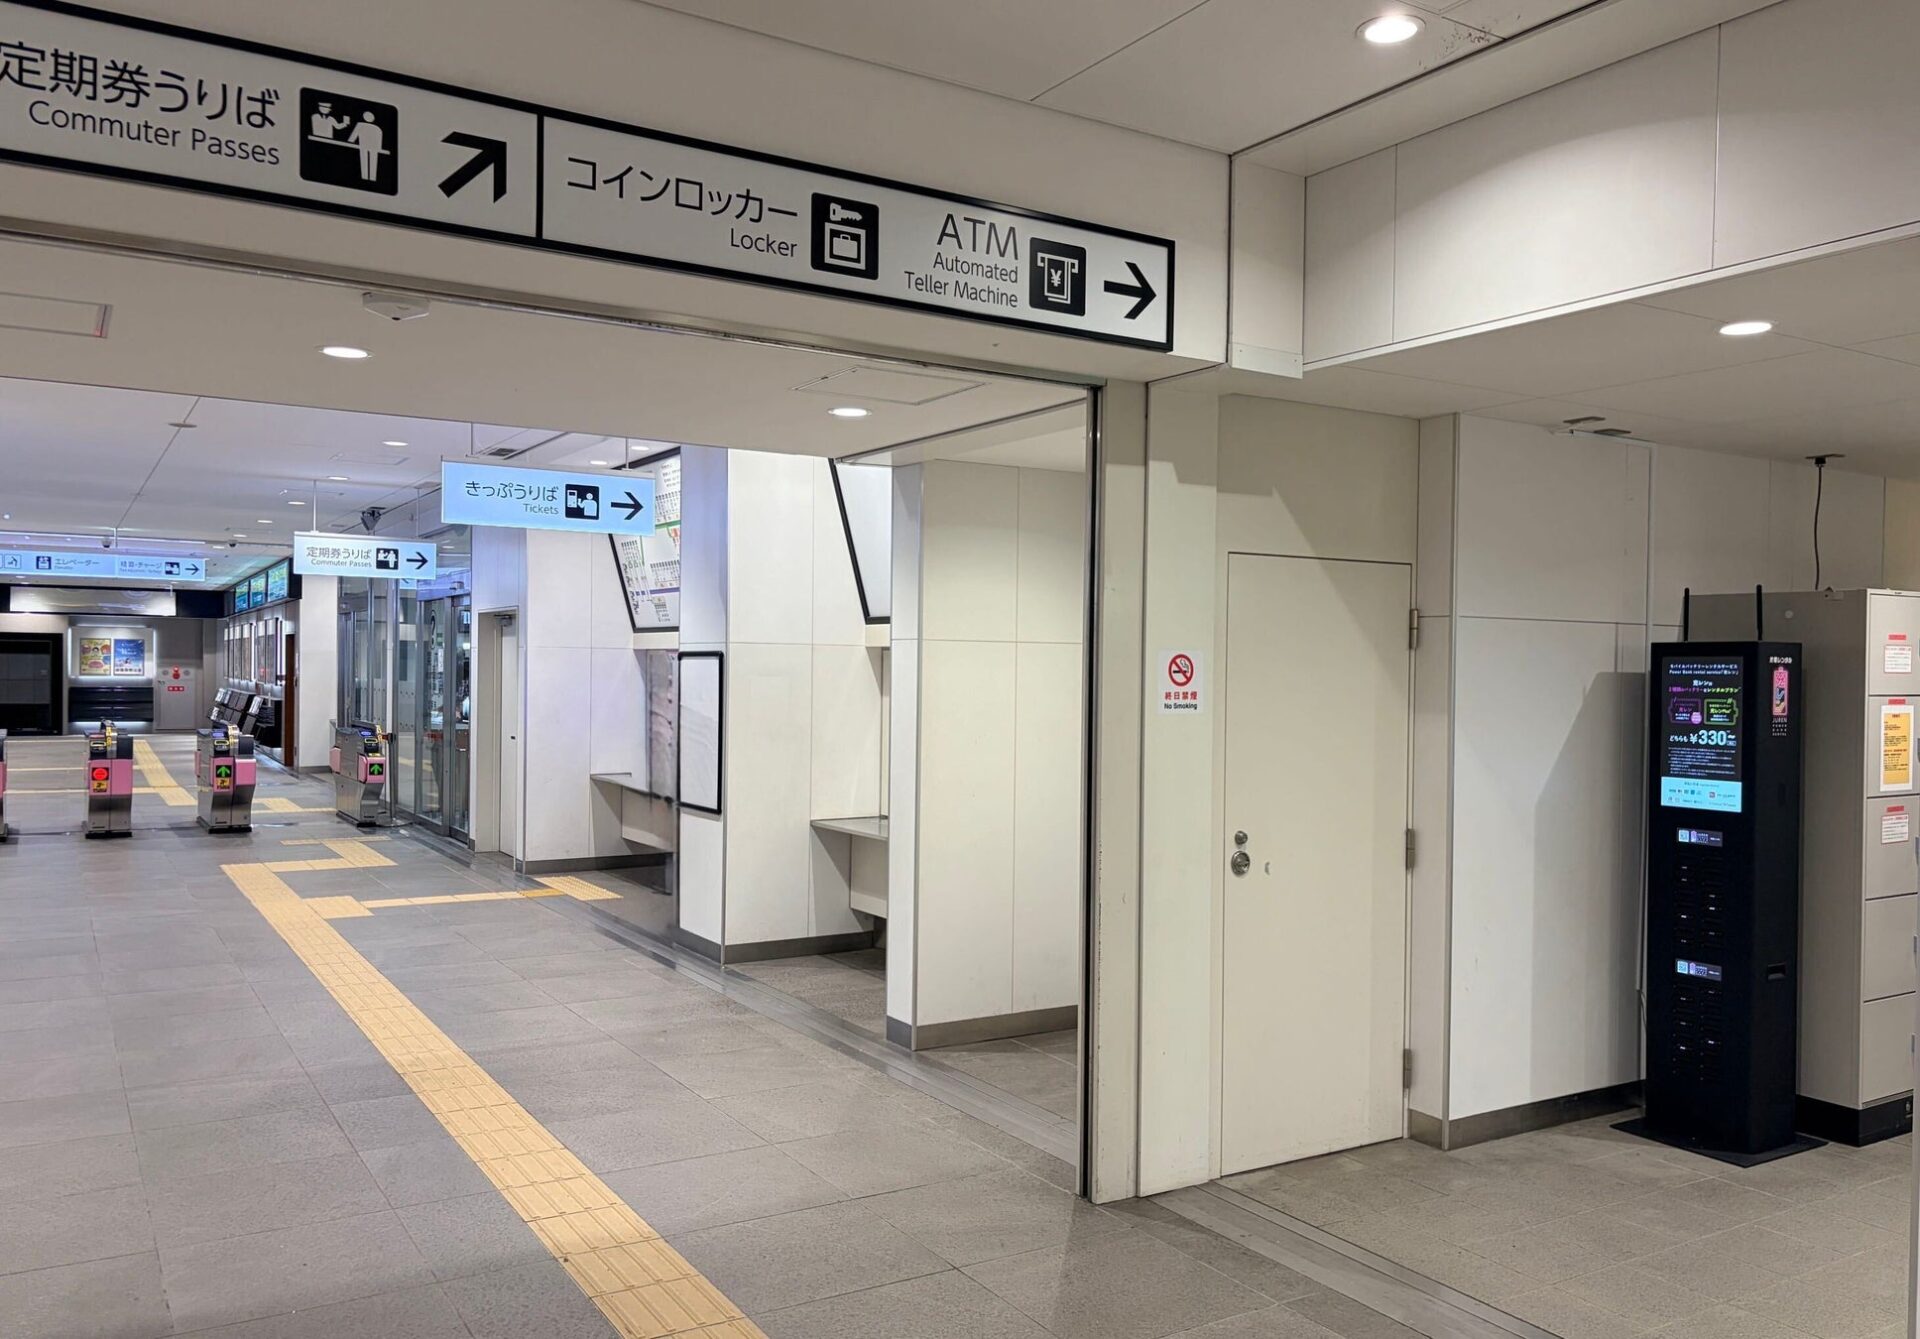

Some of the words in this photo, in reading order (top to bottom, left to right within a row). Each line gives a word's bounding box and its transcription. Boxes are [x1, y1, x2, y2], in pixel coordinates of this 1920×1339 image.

[0, 41, 281, 130] 定期券うりば
[28, 100, 181, 148] Commuter
[190, 128, 281, 167] Passes
[566, 155, 798, 224] コインロッカー
[730, 227, 798, 258] Locker
[935, 213, 1019, 261] ATM
[932, 251, 1019, 284] Automated
[904, 269, 949, 297] Teller
[953, 279, 1019, 309] Machine
[465, 480, 559, 502] きっぷうりば
[523, 503, 559, 515] Tickets
[306, 546, 372, 560] 定期券うりば
[311, 559, 348, 567] Commuter
[1165, 691, 1197, 700] 終日禁煙
